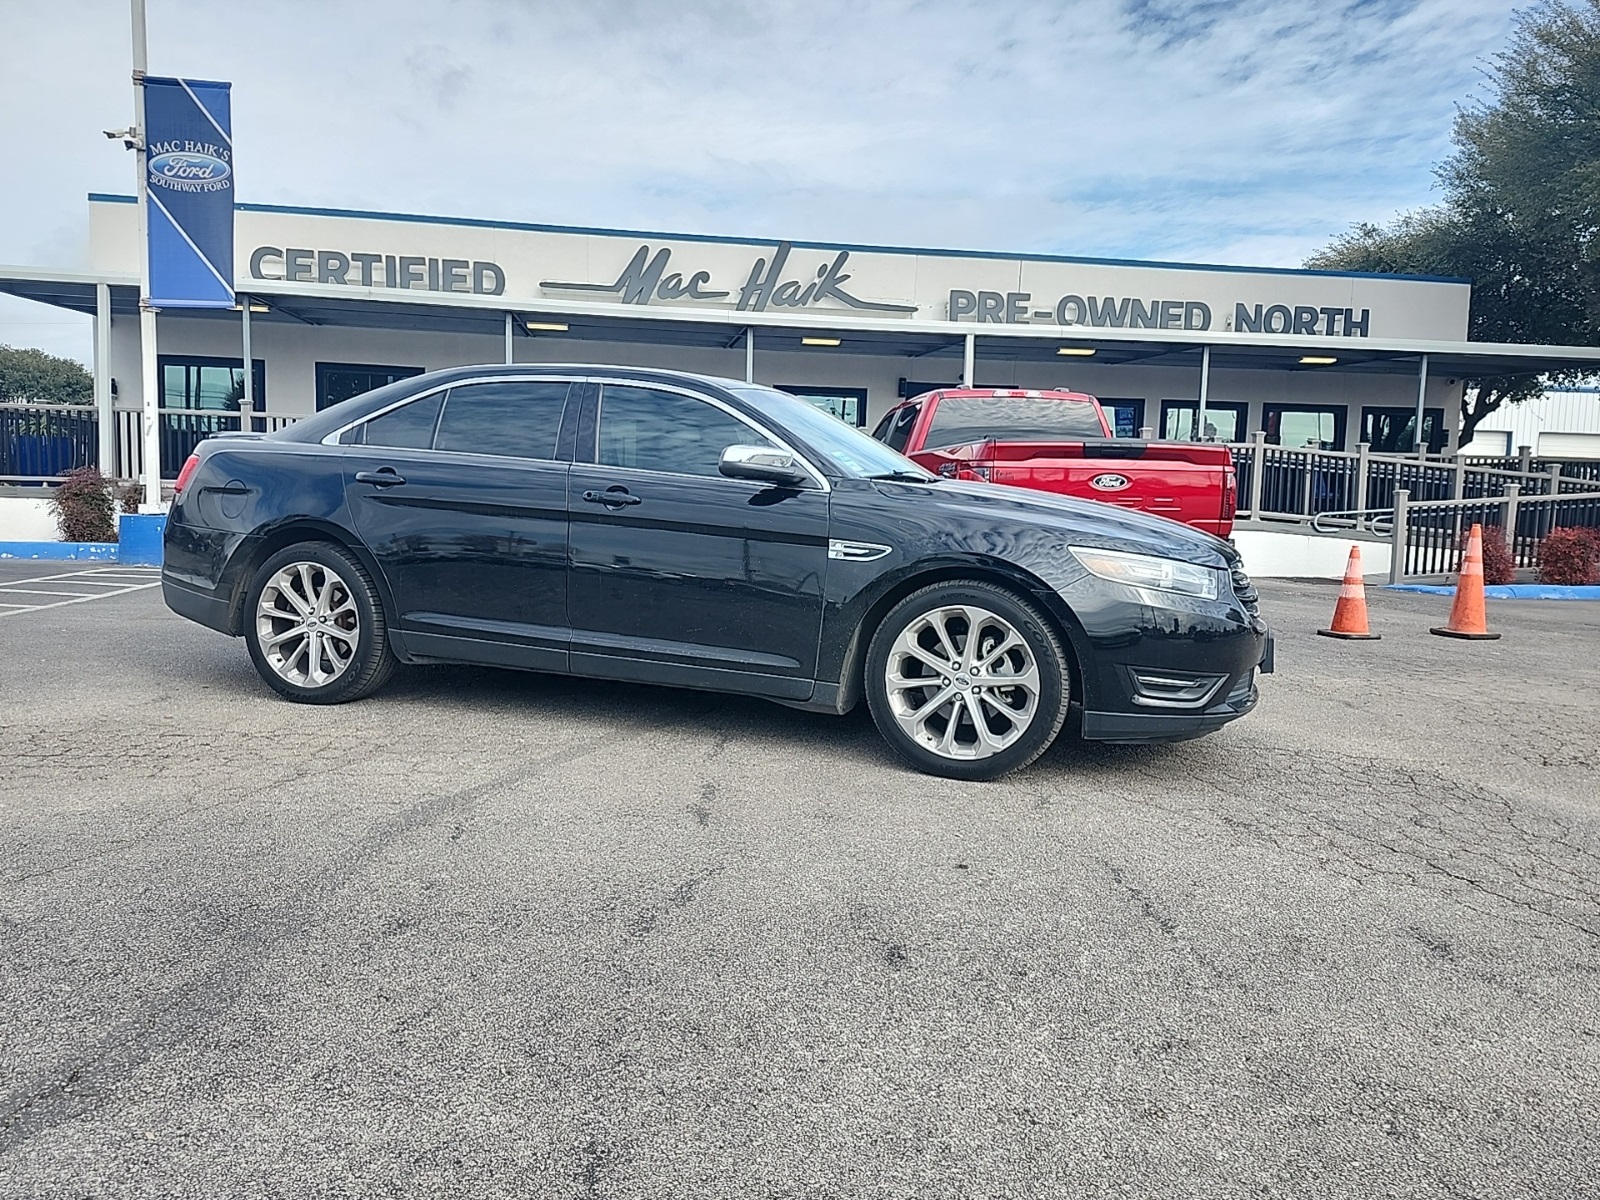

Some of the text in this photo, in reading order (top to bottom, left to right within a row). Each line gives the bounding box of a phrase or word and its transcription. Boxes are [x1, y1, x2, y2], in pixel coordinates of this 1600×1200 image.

[149, 140, 230, 161] MAC HAIK'S
[164, 156, 215, 179] Ford
[149, 174, 230, 193] SOUTHWAY FORD
[249, 246, 506, 296] CERTIFIED
[539, 240, 919, 313] Mac Haik
[949, 289, 1370, 338] PRE-OWNED NORTH
[1098, 475, 1122, 488] Ford
